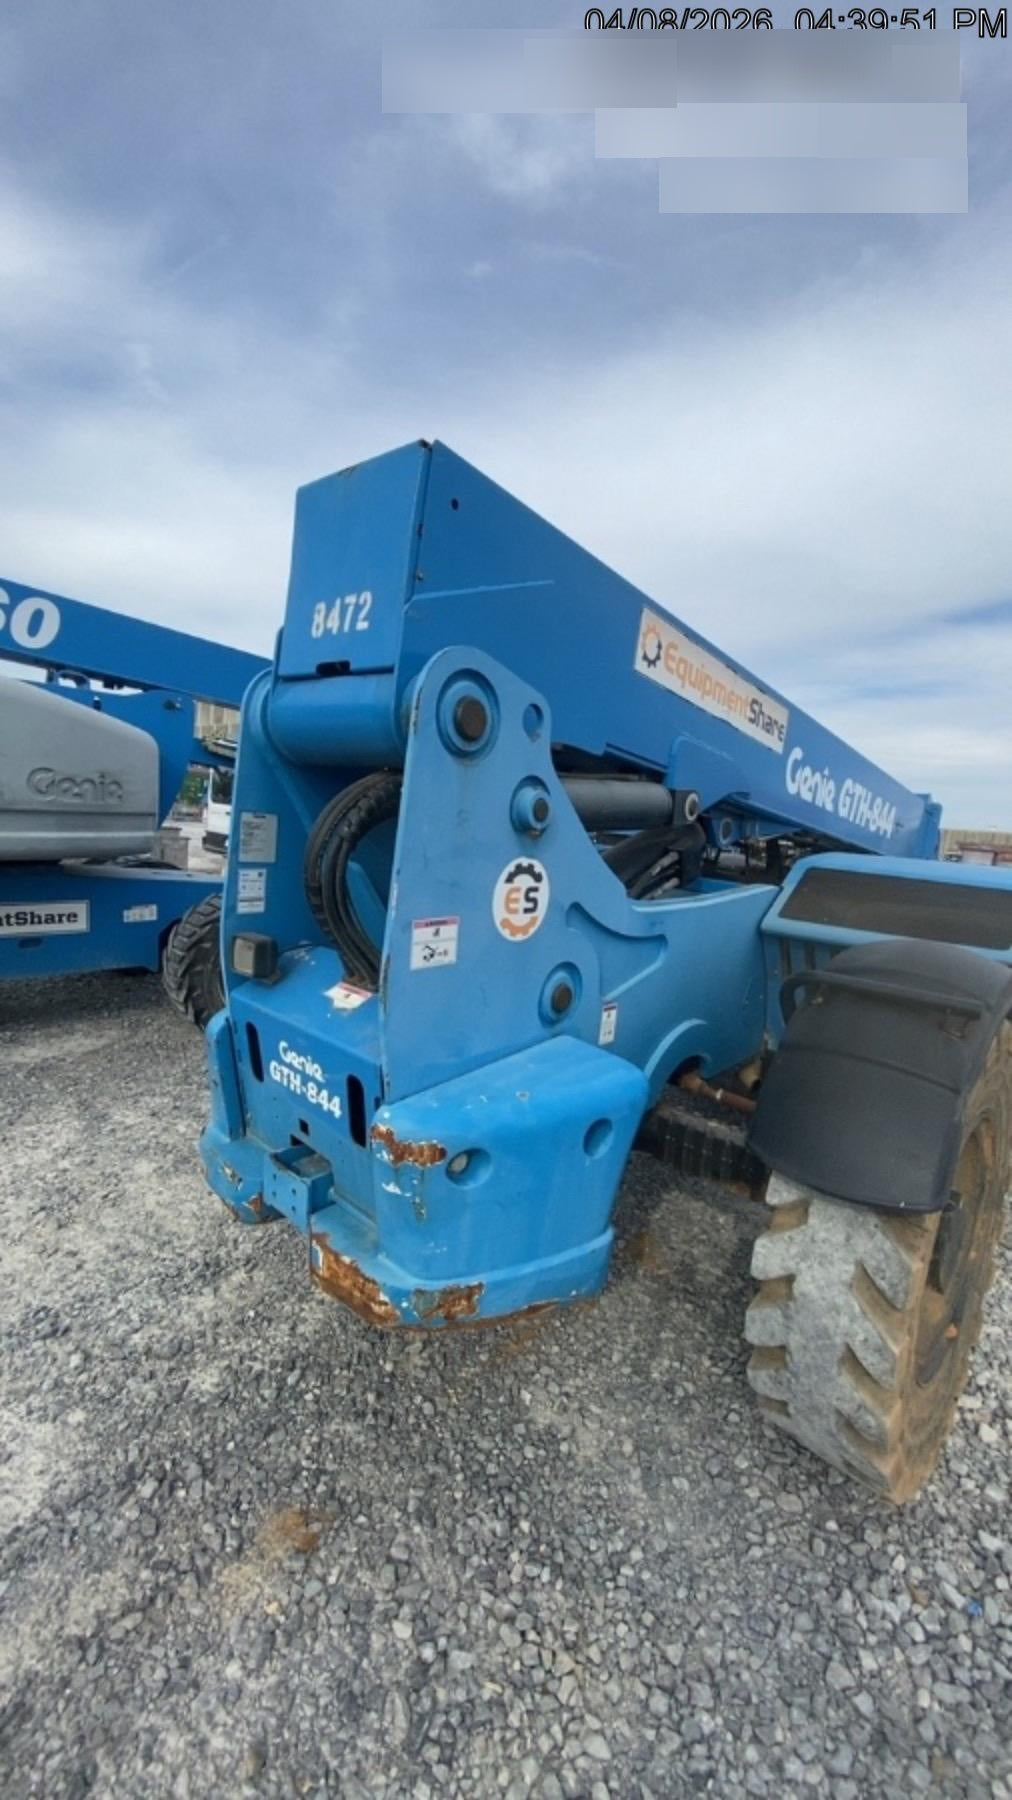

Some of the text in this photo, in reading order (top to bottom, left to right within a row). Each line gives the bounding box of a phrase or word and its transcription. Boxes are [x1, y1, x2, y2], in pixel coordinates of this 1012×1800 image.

[0, 586, 60, 650] 0
[311, 591, 372, 639] 8472
[664, 641, 785, 742] EquipmentShare
[26, 767, 123, 803] Genie
[786, 747, 896, 839] Genie GTH-844
[0, 911, 79, 928] tShare
[504, 886, 540, 915] ES
[279, 1040, 326, 1084] Genie
[268, 1060, 342, 1119] GTH-844
